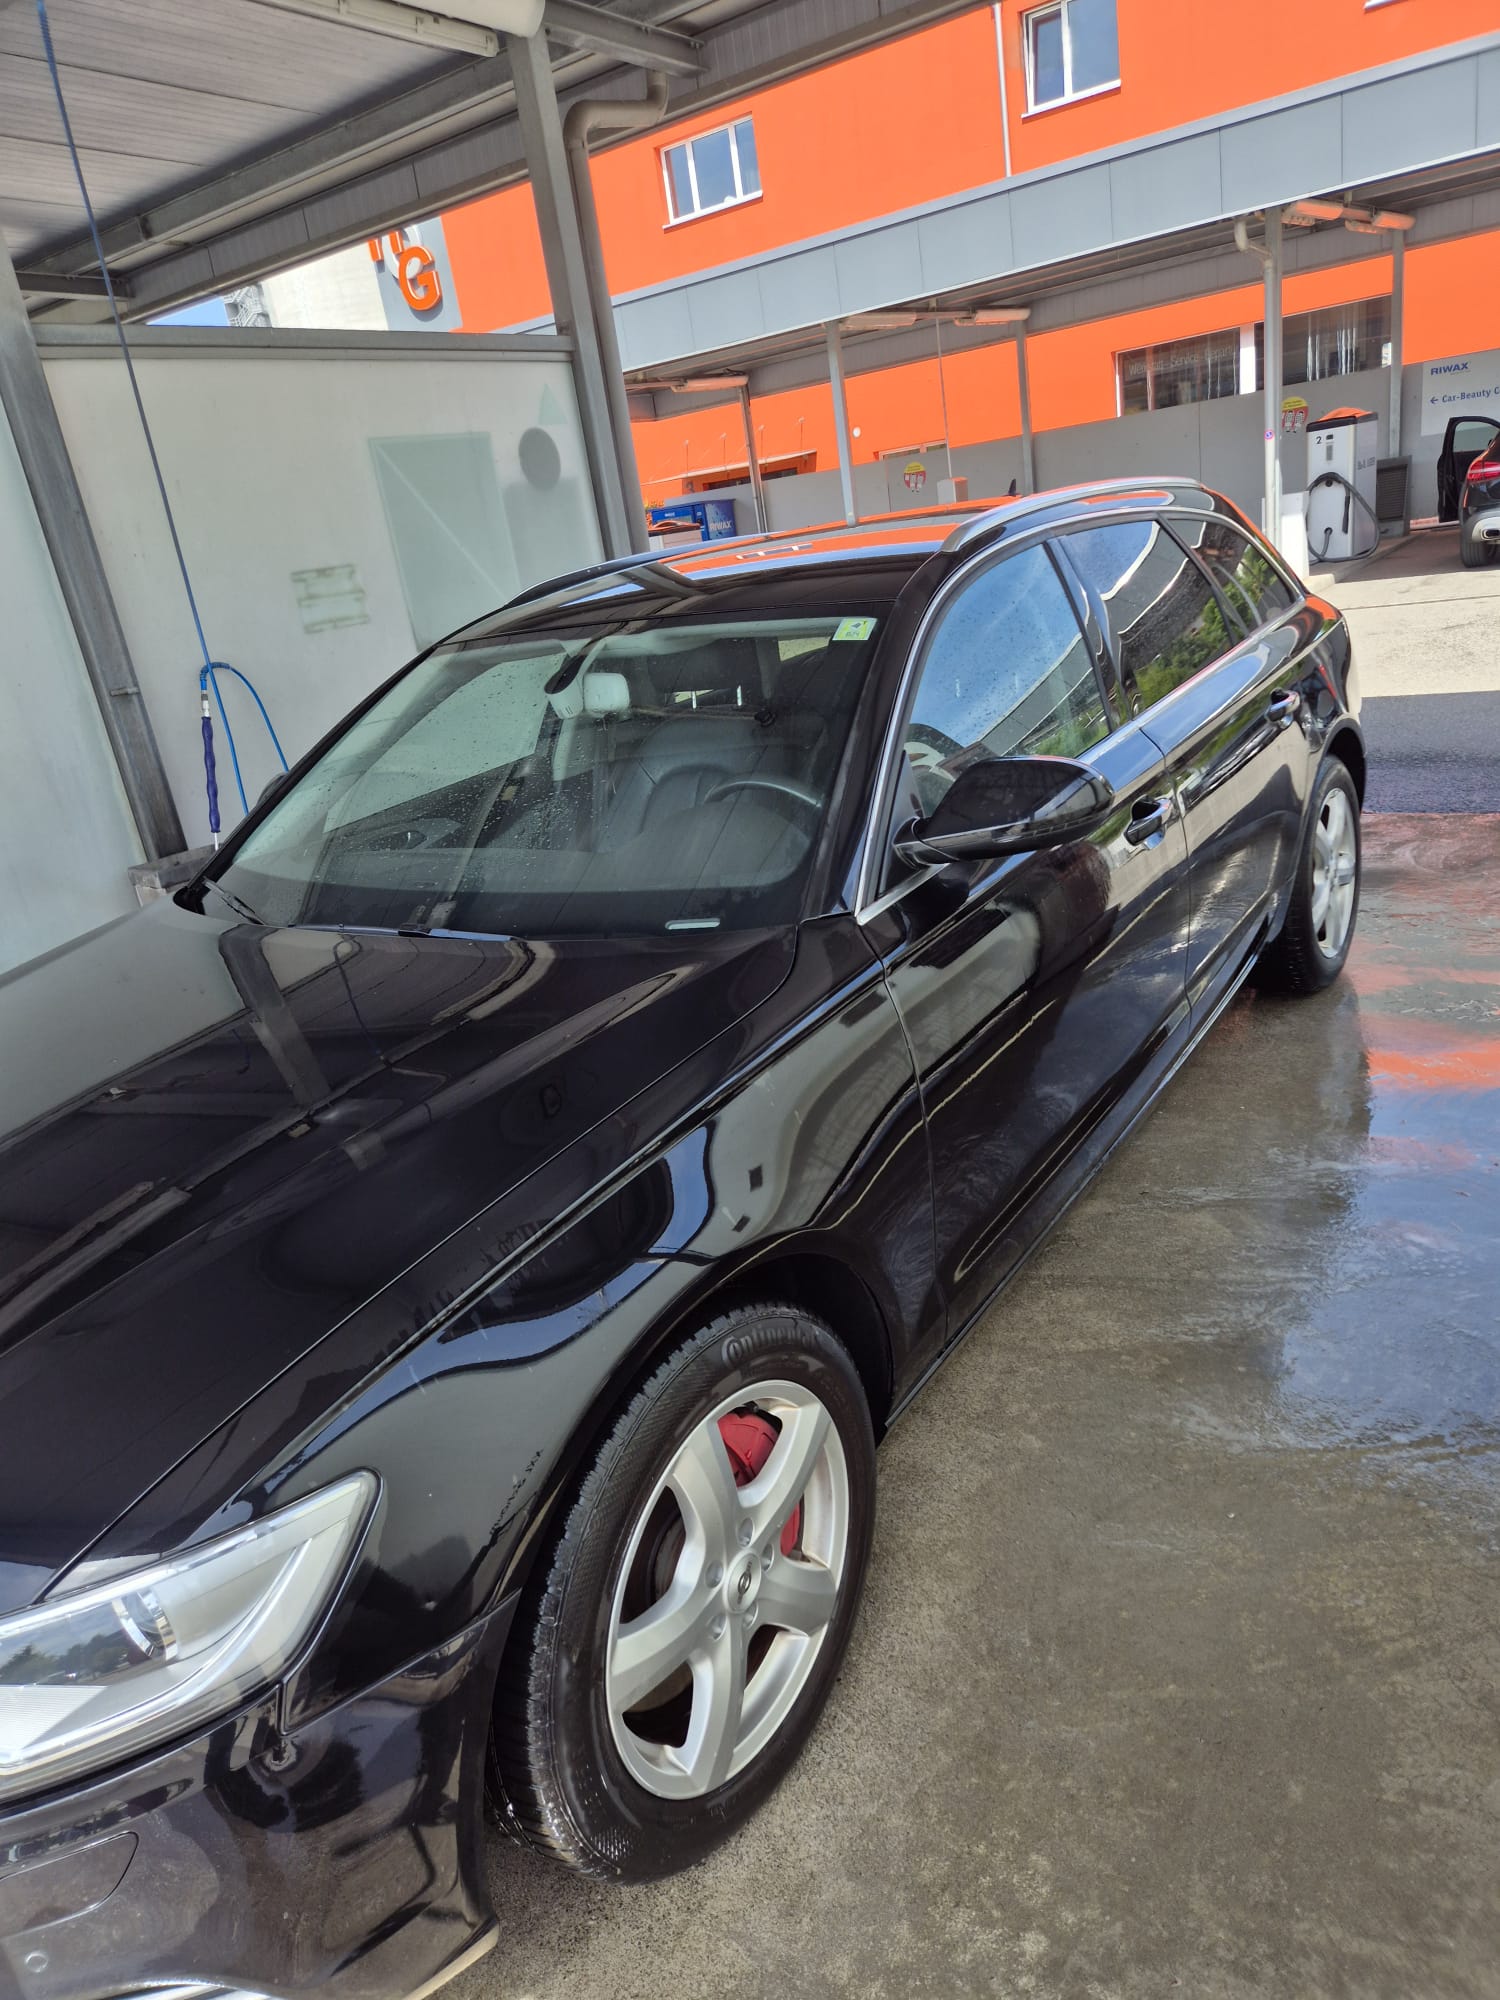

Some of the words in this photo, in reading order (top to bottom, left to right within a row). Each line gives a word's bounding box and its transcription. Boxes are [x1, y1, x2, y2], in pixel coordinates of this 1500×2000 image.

[1430, 362, 1469, 375] RIWAX
[1442, 389, 1491, 402] Car-Beauty
[1315, 435, 1322, 445] 2
[709, 520, 732, 531] RIWAX
